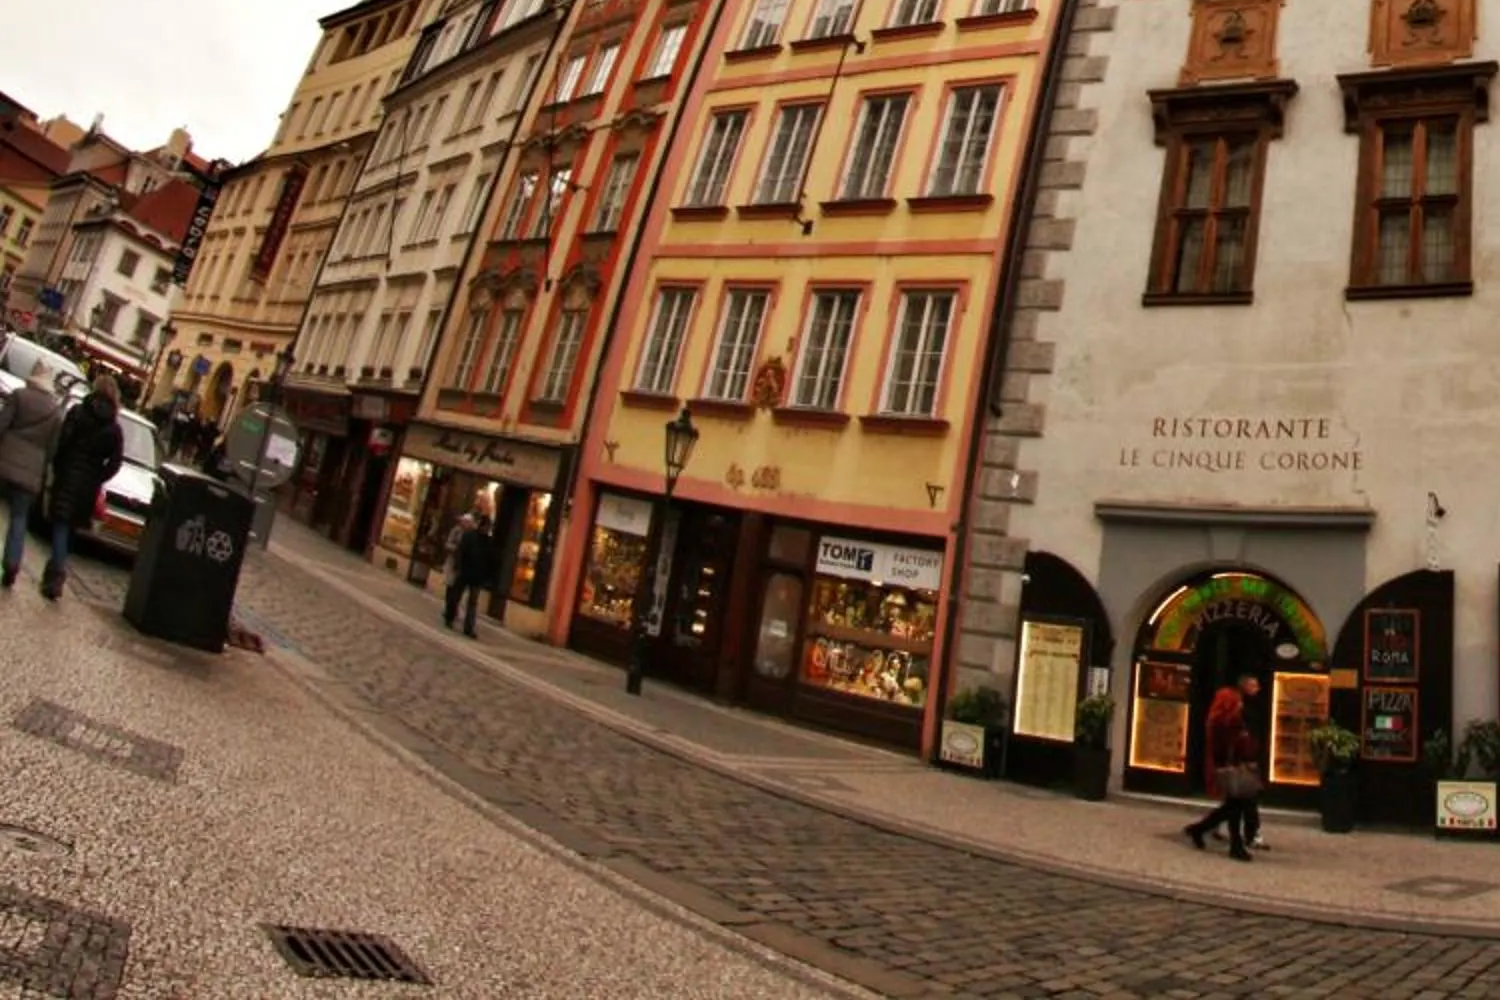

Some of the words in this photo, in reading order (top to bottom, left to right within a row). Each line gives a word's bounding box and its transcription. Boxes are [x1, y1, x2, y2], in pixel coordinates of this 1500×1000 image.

[1152, 416, 1330, 440] RISTORANTE
[1118, 448, 1140, 467] LE
[1152, 449, 1245, 472] CINQUE
[1258, 450, 1365, 471] CORONE
[821, 542, 857, 560] TOM
[893, 551, 940, 569] FACTORY
[890, 566, 920, 580] SHOP
[1195, 599, 1281, 639] PIZZERIA
[1371, 649, 1410, 664] ROMA
[1367, 692, 1412, 712] PIZZA
